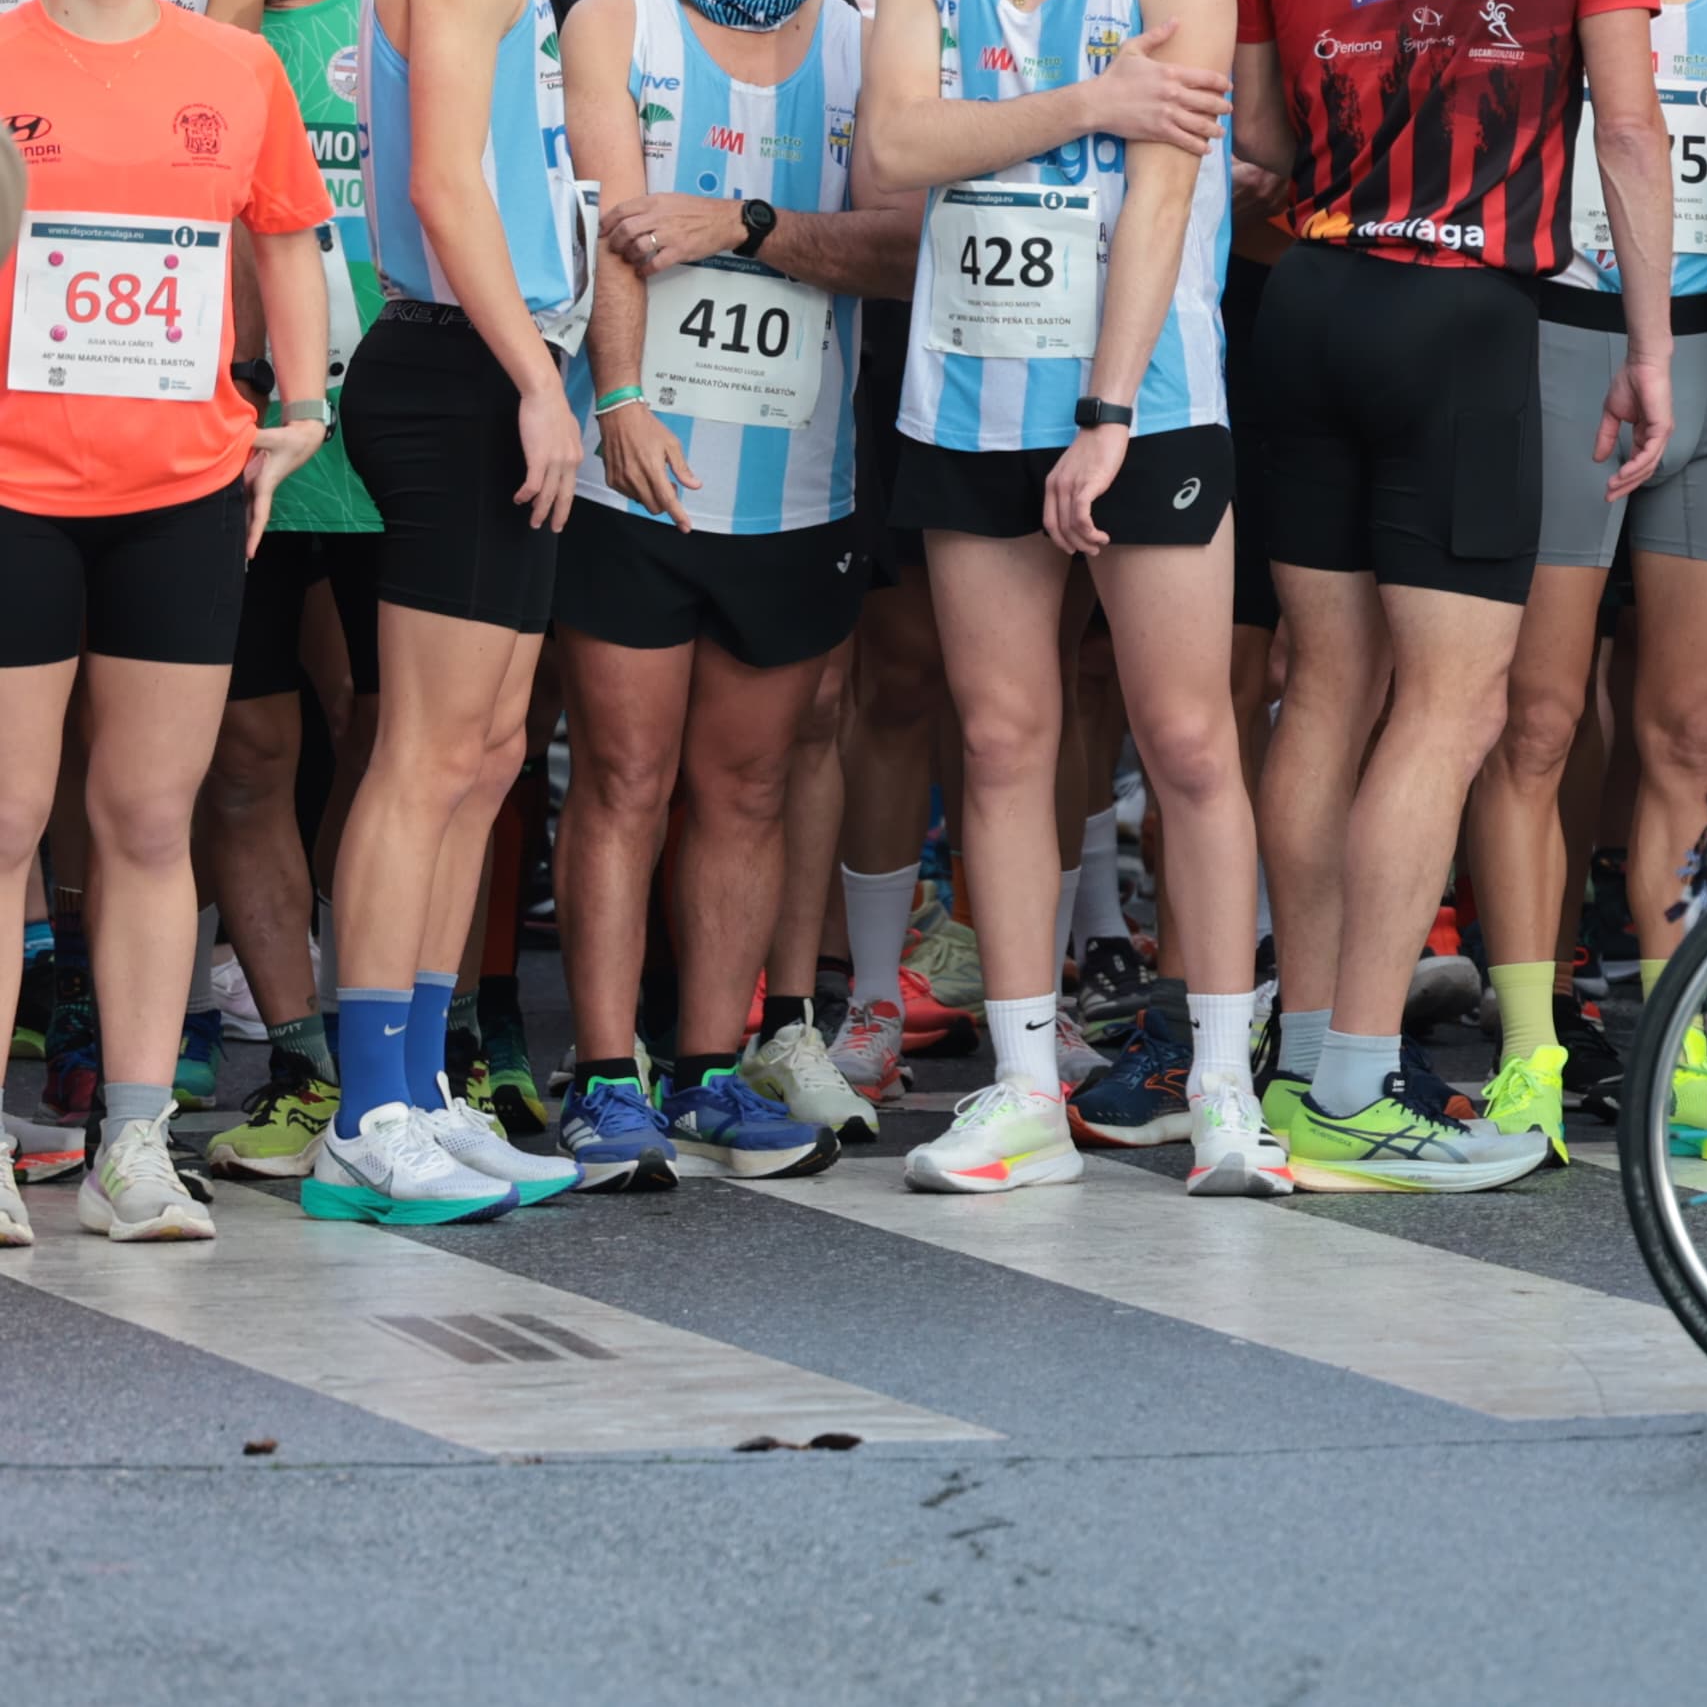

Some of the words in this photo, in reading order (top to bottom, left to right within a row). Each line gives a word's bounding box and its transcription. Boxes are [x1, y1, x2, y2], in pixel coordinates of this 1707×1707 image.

[1684, 214, 1693, 222] EL
[48, 226, 145, 240] www.deporte.malaga.eu
[960, 235, 1054, 288] 428
[65, 271, 182, 328] 684
[679, 298, 790, 358] 410
[1002, 314, 1023, 325] PEÑA
[1025, 317, 1035, 325] EL
[1037, 316, 1071, 326] BASTÓN
[77, 354, 121, 364] MARATÓN
[122, 356, 146, 365] PEÑA
[148, 358, 158, 366] EL
[161, 357, 196, 367] BASTÓN
[669, 374, 687, 383] MINI
[688, 376, 730, 389] MARATÓN
[731, 381, 752, 392] PEÑA
[754, 385, 764, 393] EL
